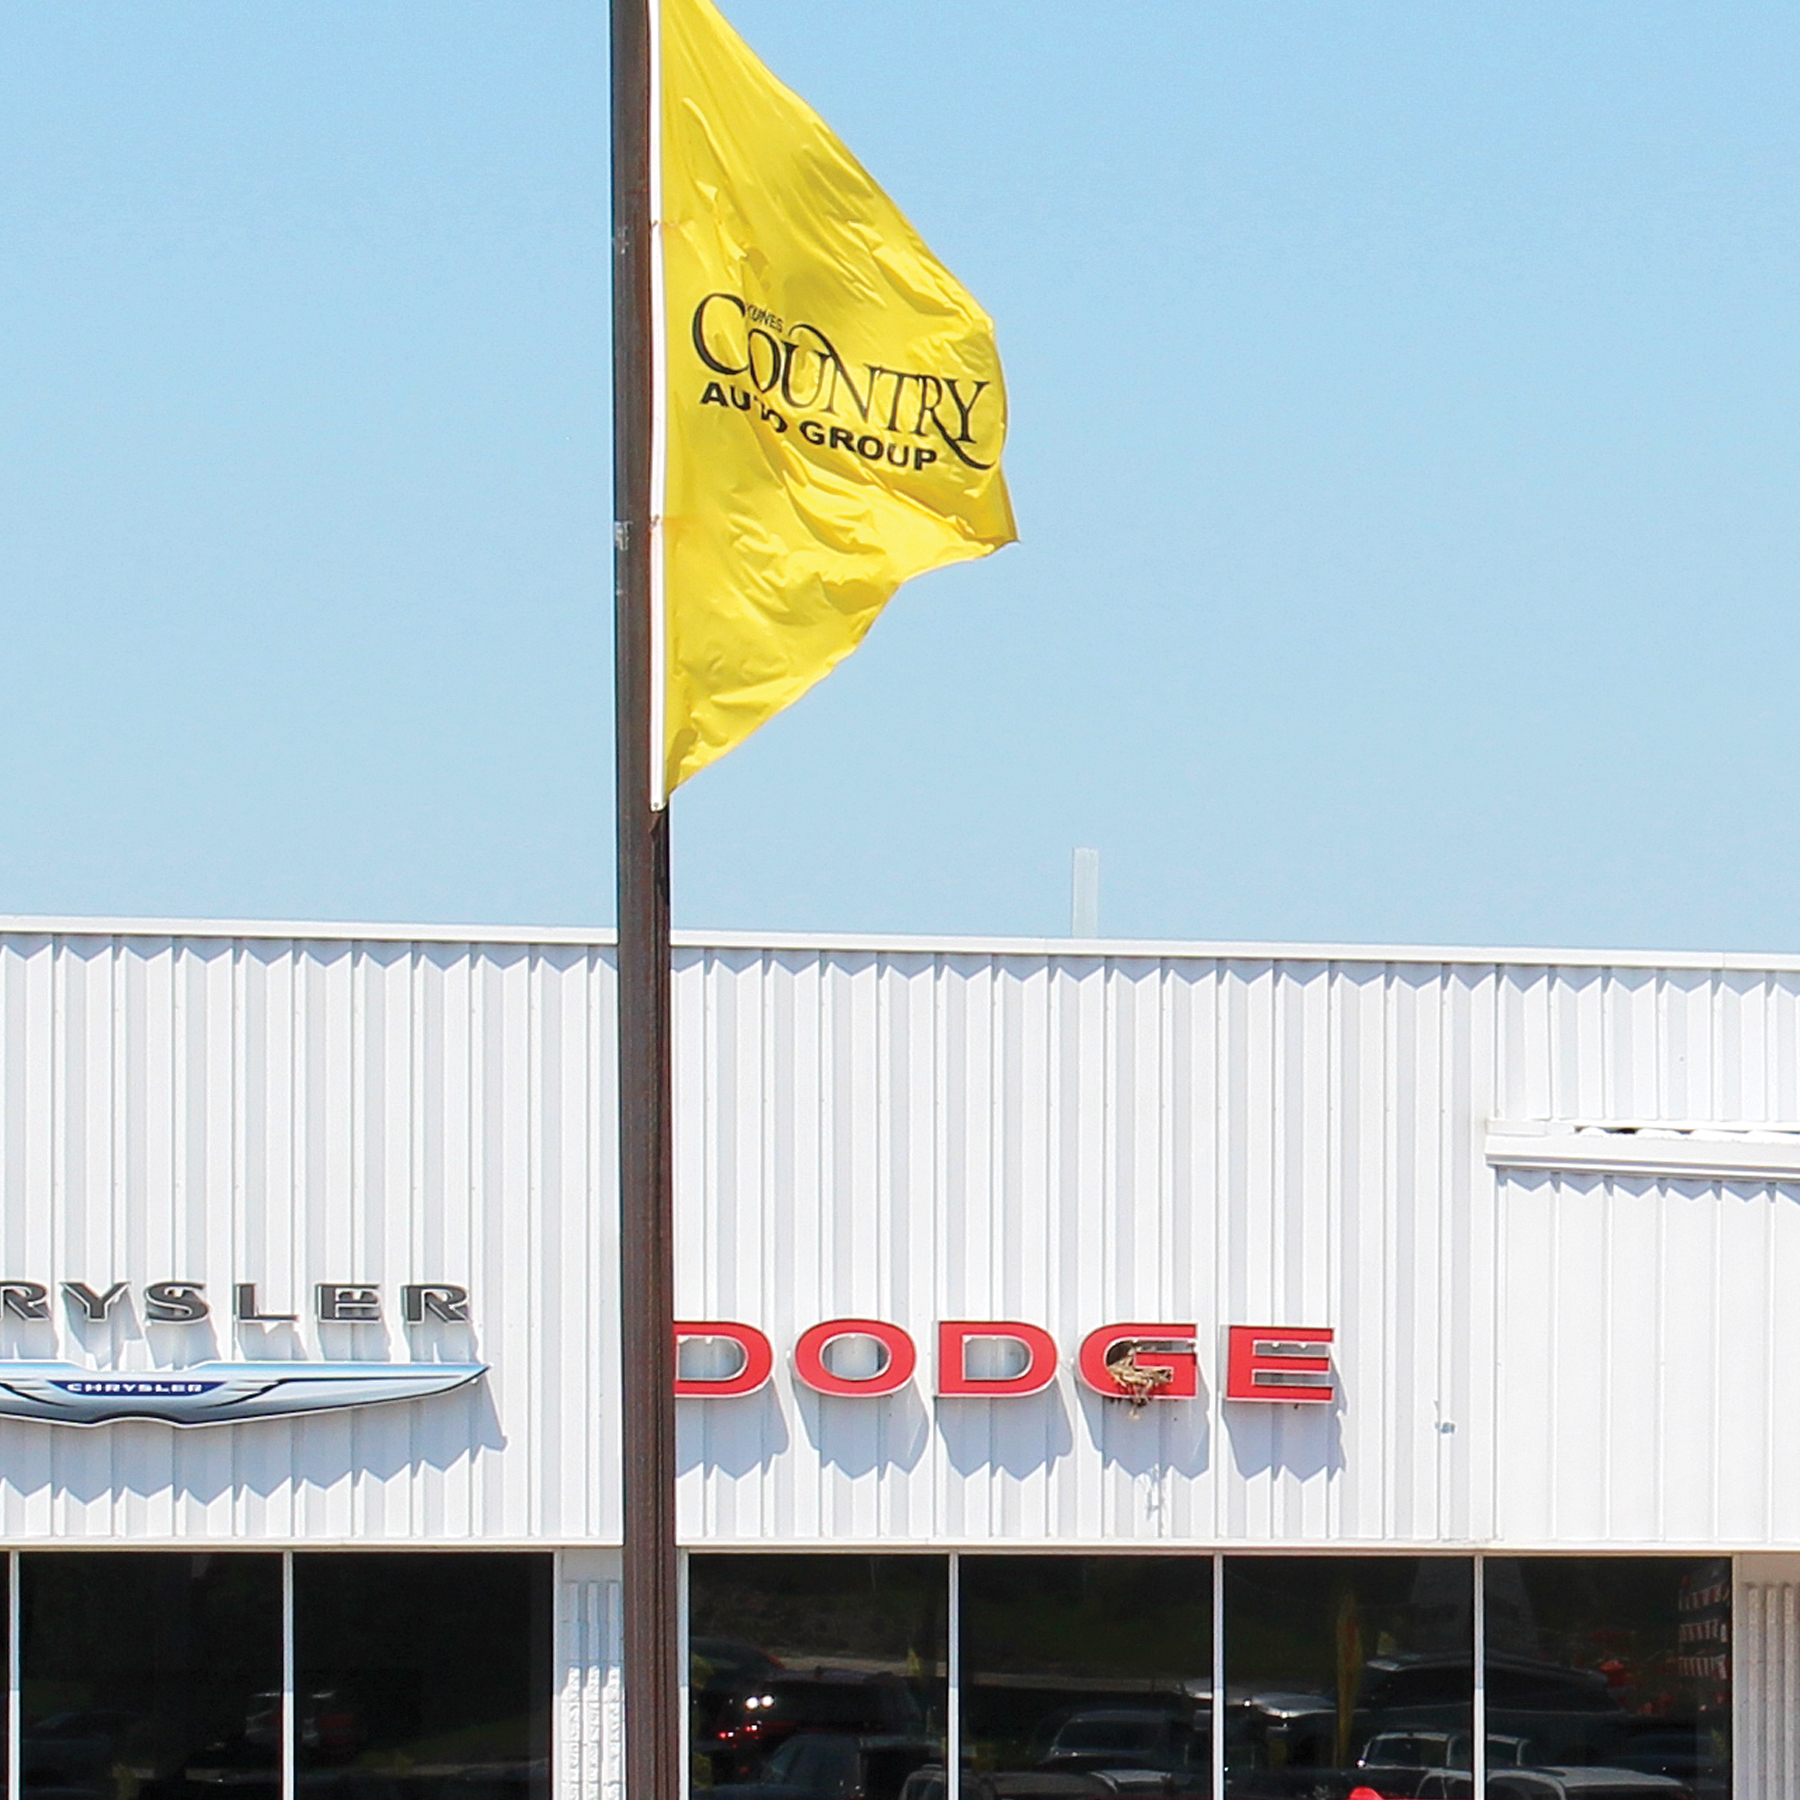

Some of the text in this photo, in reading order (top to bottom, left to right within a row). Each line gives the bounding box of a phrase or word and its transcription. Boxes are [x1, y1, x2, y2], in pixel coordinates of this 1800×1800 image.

[692, 293, 997, 471] COUNTRY
[799, 420, 937, 471] GROUP
[66, 1382, 202, 1393] CHRYSLER
[674, 1318, 1336, 1403] DODGE
